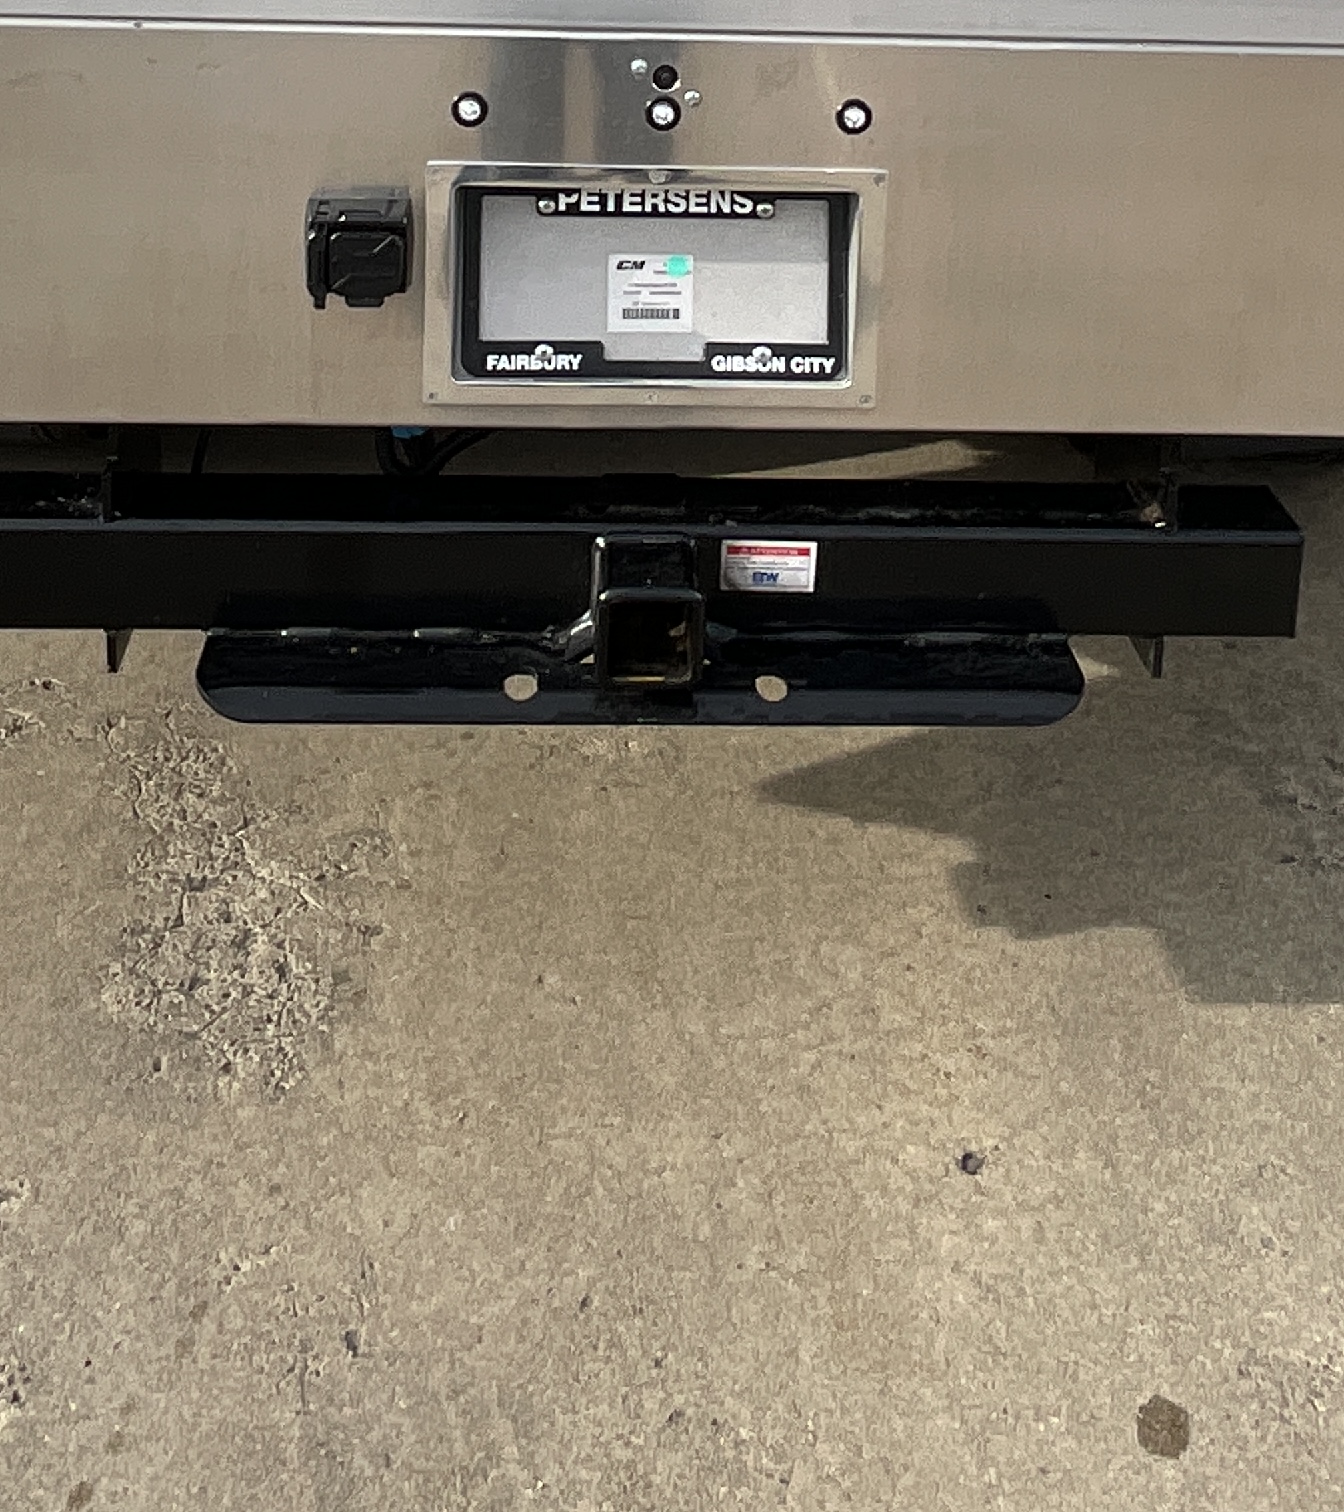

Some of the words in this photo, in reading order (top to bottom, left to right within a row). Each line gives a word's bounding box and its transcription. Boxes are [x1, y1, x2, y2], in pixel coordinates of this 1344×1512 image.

[558, 189, 754, 214] PETERSENS
[486, 354, 584, 371] FAIRBURY
[711, 354, 786, 373] GIBSON
[790, 356, 836, 374] CITY
